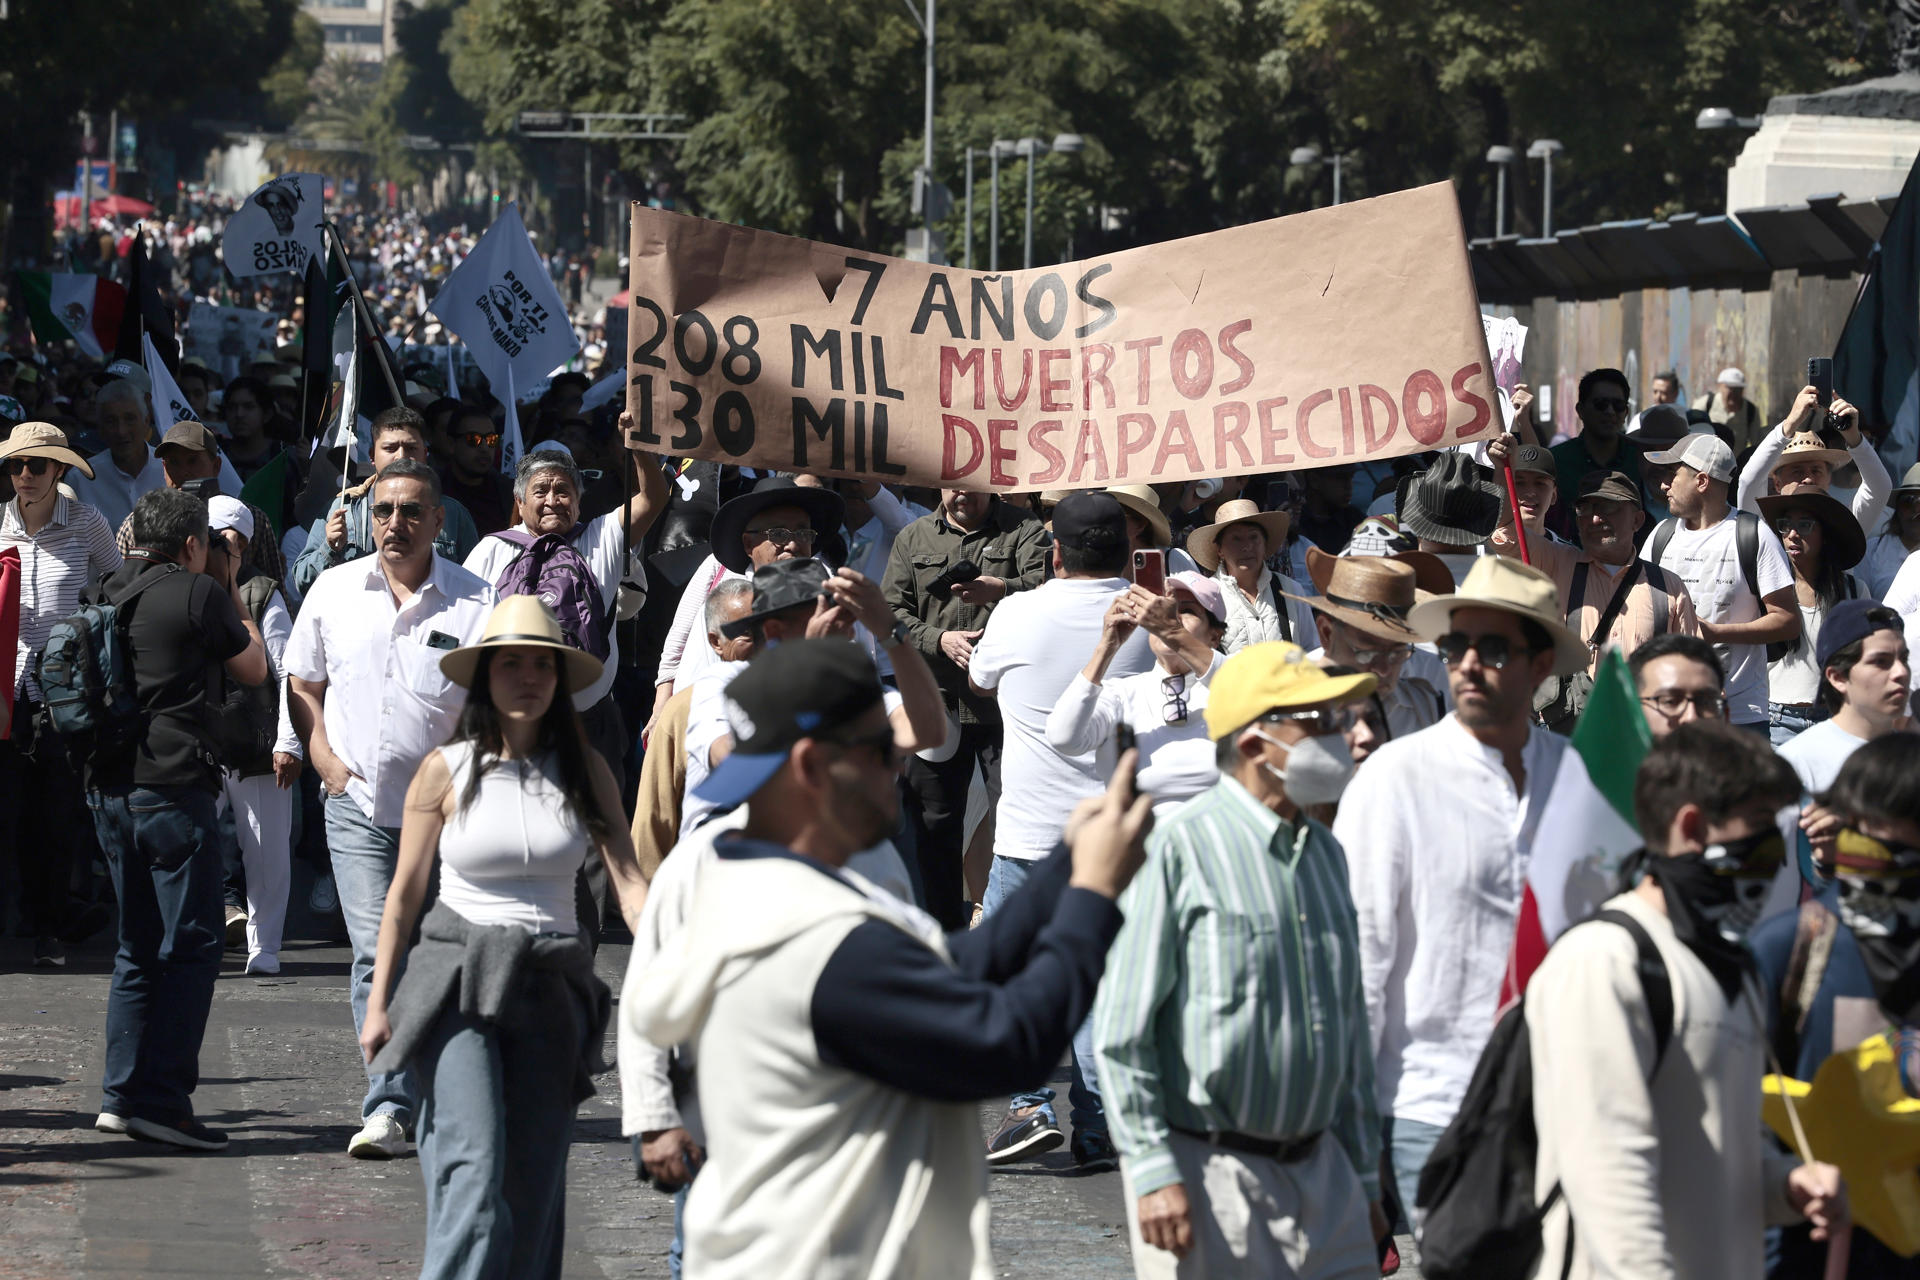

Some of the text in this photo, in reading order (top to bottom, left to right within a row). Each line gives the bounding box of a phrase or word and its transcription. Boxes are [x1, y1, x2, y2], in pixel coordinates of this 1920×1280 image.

[504, 270, 549, 322] POR TI
[842, 257, 1117, 340] 7 AÑOS
[492, 327, 522, 358] MANZO
[632, 296, 1256, 412] 208 MIL MUERTOS
[631, 362, 1491, 487] 130 MIL DESAPARECIDOS
